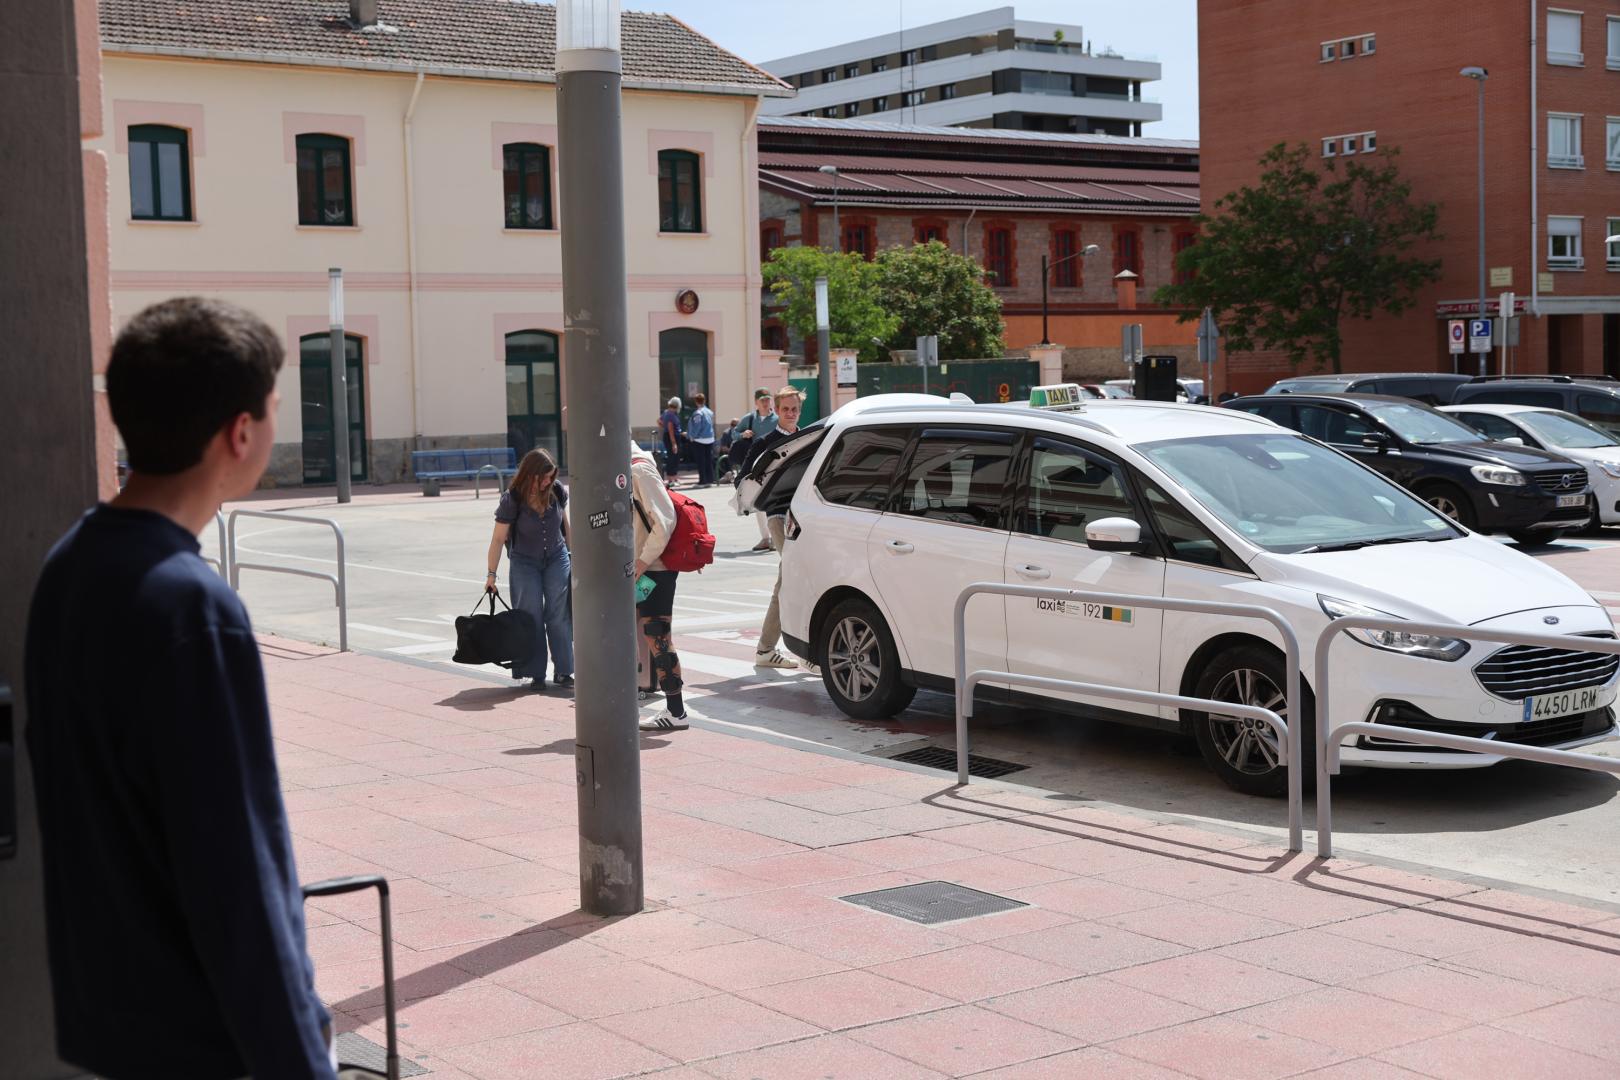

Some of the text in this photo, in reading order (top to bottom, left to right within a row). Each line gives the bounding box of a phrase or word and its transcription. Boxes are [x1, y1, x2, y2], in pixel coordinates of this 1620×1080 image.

[1473, 321, 1484, 336] P
[1047, 388, 1069, 403] TAXI
[590, 513, 604, 523] PLATA
[1083, 603, 1101, 618] 192
[1534, 689, 1597, 717] 4450 LRM
